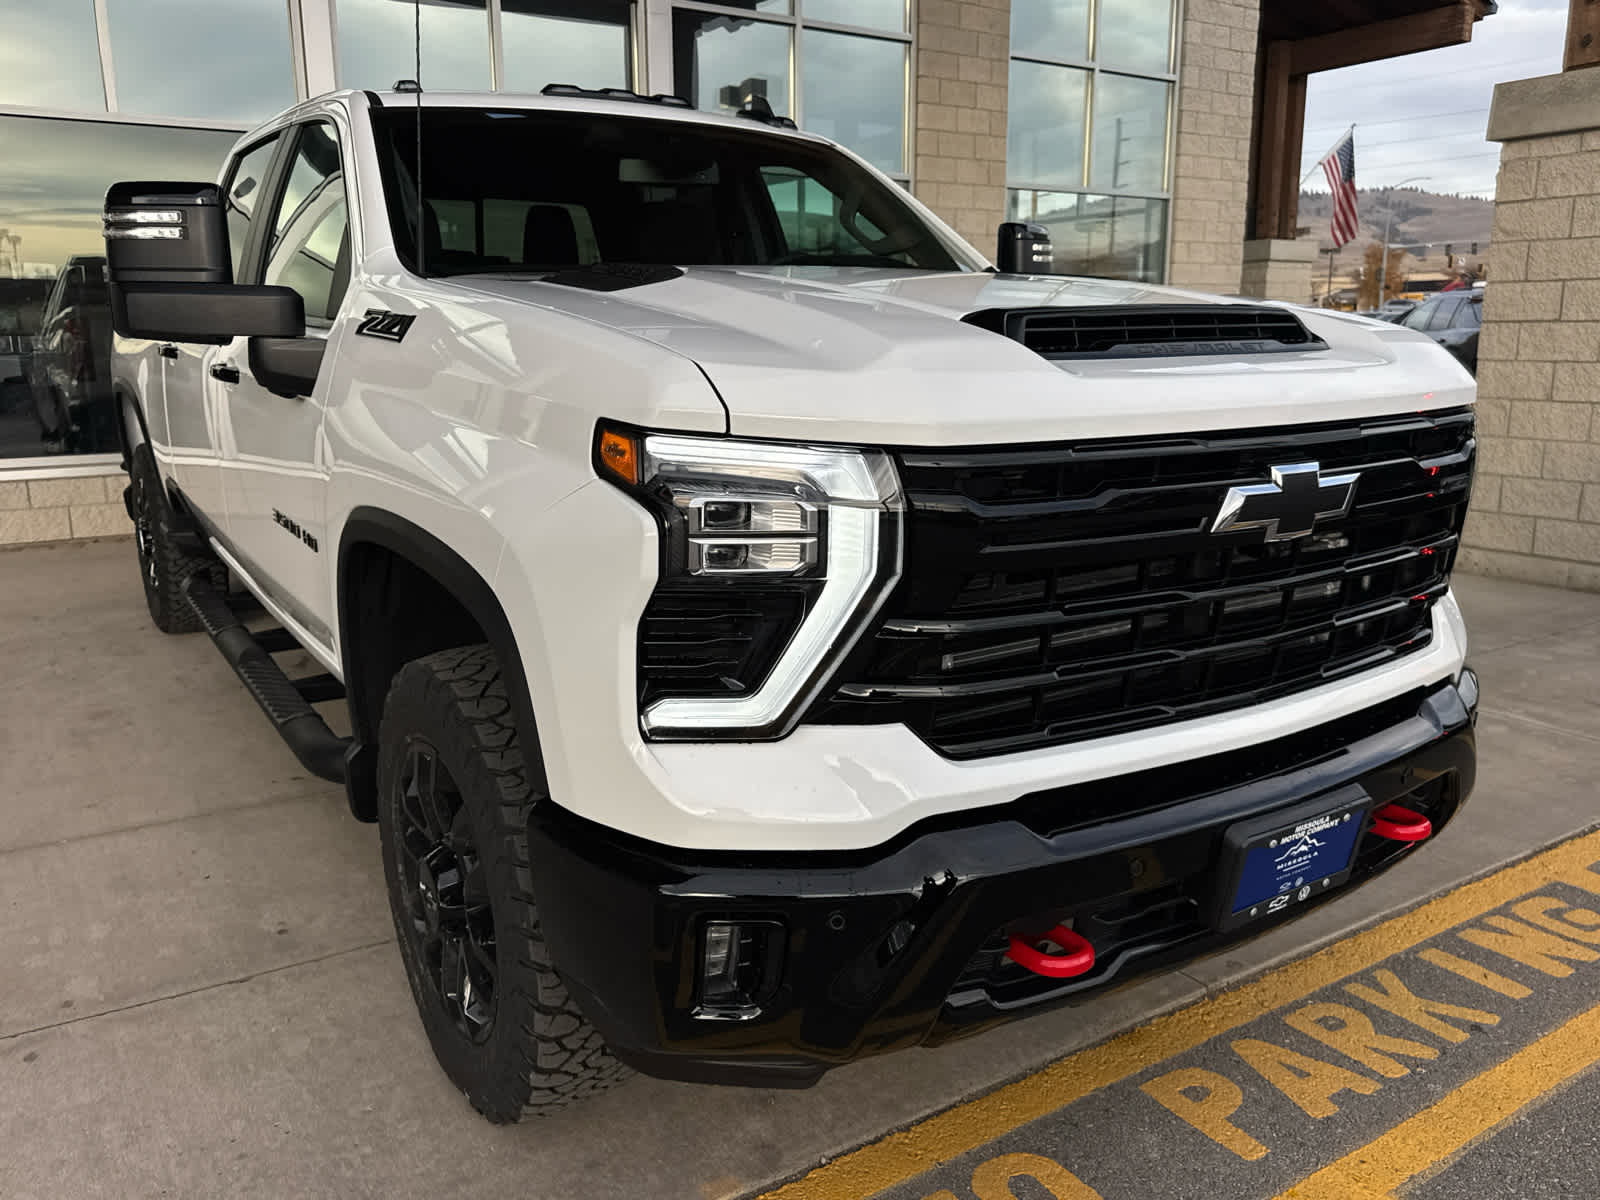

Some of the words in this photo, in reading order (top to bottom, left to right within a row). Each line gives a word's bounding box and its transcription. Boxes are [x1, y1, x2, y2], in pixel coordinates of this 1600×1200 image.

[1280, 831, 1306, 845] MOTOR
[1306, 818, 1340, 836] COMPANY
[1295, 815, 1330, 833] MISSOULA
